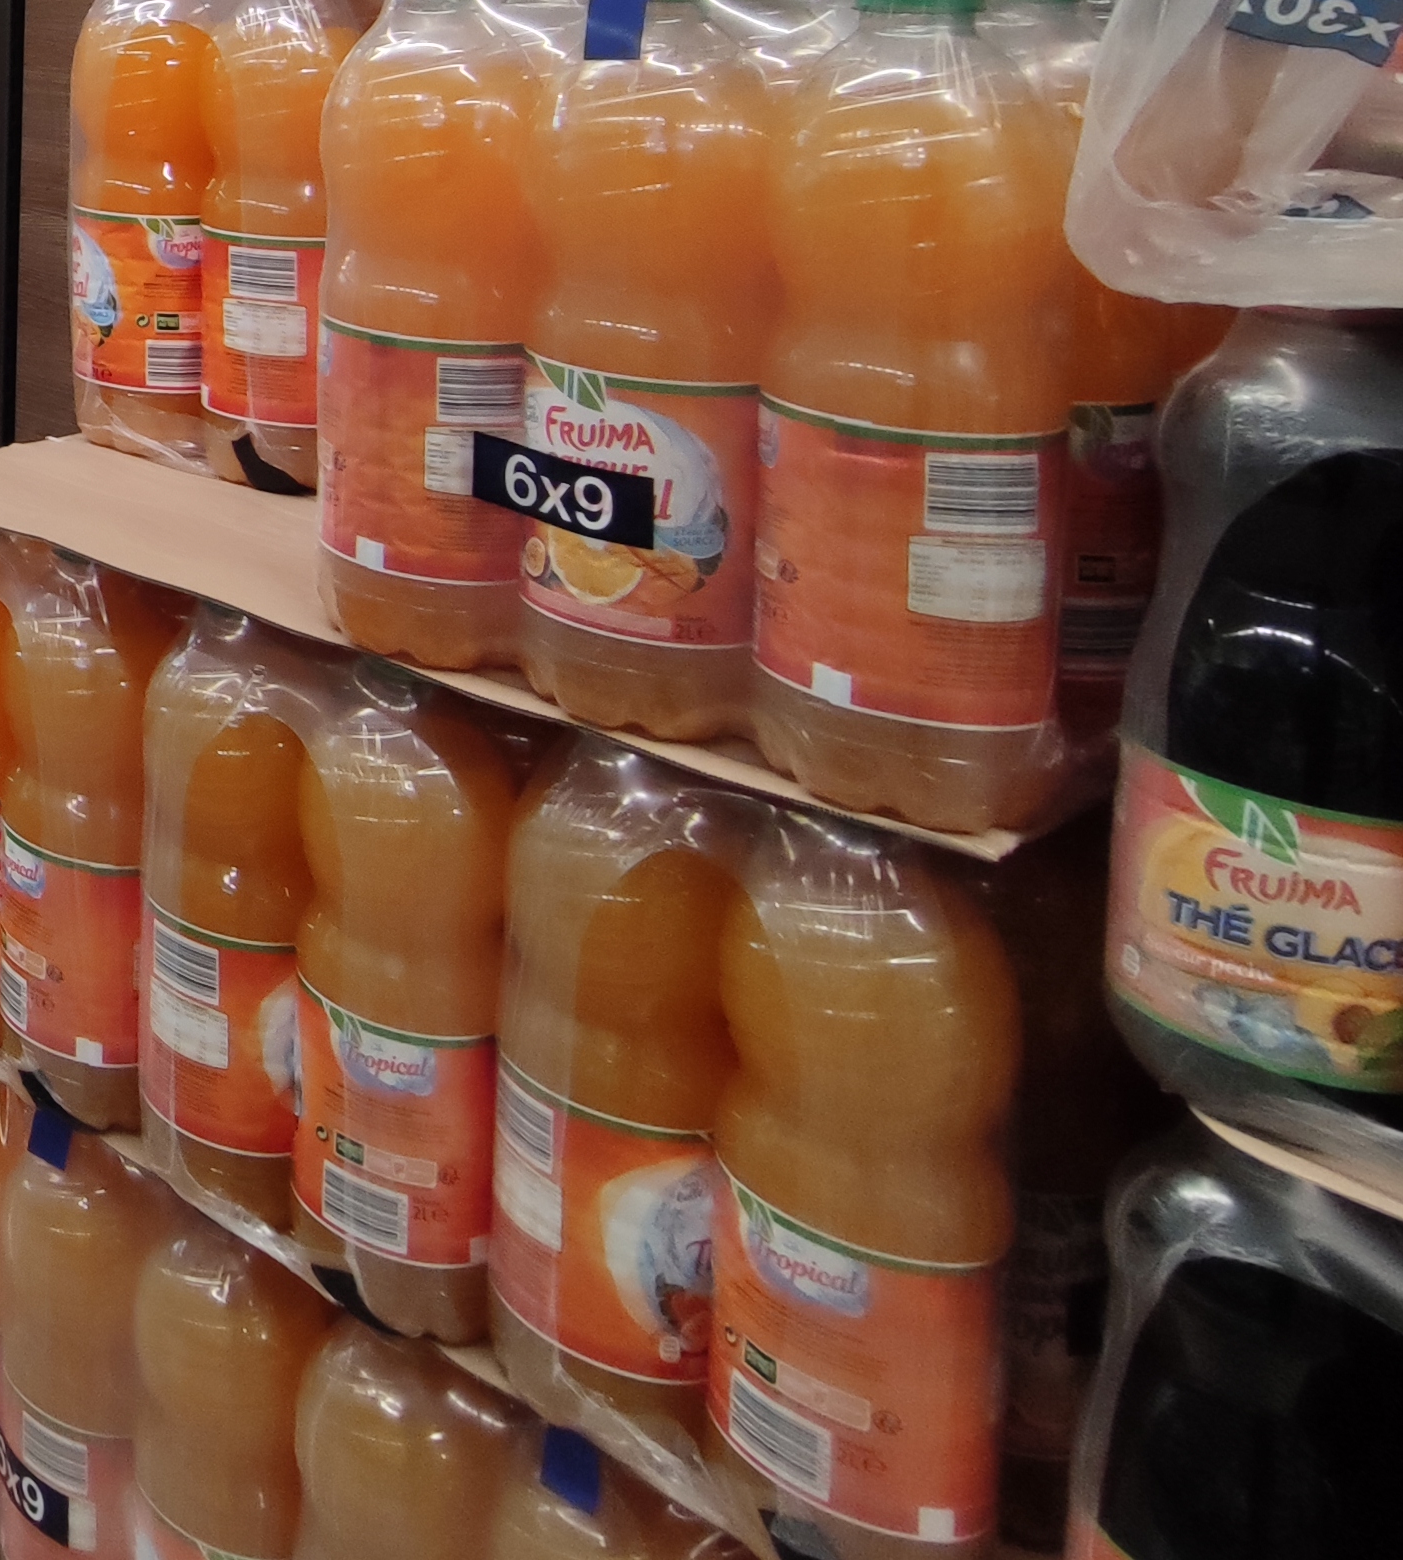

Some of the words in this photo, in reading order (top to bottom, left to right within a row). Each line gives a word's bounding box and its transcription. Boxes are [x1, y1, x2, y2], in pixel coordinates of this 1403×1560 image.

[545, 405, 655, 455] FRUIMA
[504, 453, 614, 531] 6x9
[1204, 847, 1362, 916] FRUIMA
[1166, 888, 1255, 948] THÉ
[1264, 924, 1403, 971] GLAC
[345, 1042, 427, 1079] Tropical
[755, 1233, 858, 1295] Tropical
